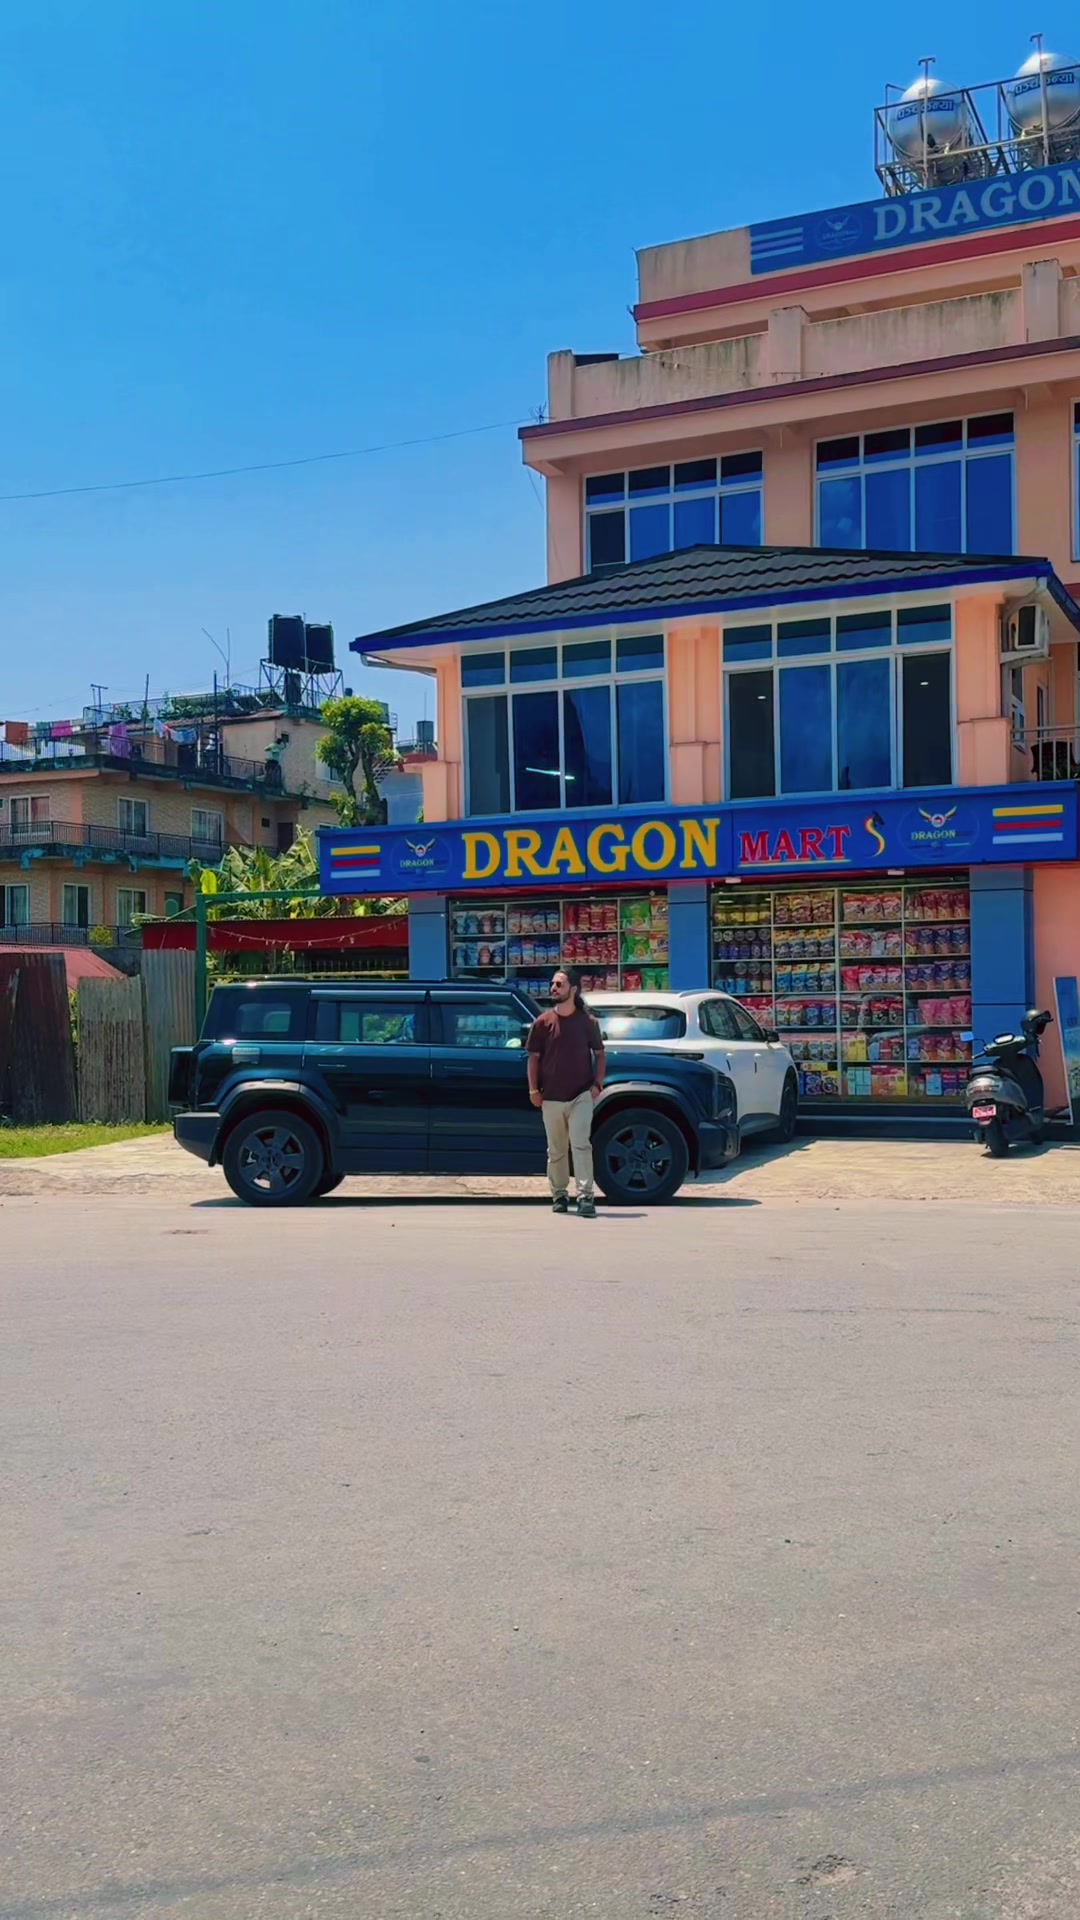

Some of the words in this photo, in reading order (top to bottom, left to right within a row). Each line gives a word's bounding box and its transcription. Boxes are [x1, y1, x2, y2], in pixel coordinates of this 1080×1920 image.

[873, 169, 1080, 241] DRAGON
[461, 818, 721, 879] DRAGON
[738, 825, 851, 863] MART
[910, 829, 956, 841] DRAGON
[399, 859, 434, 869] DRAGON
